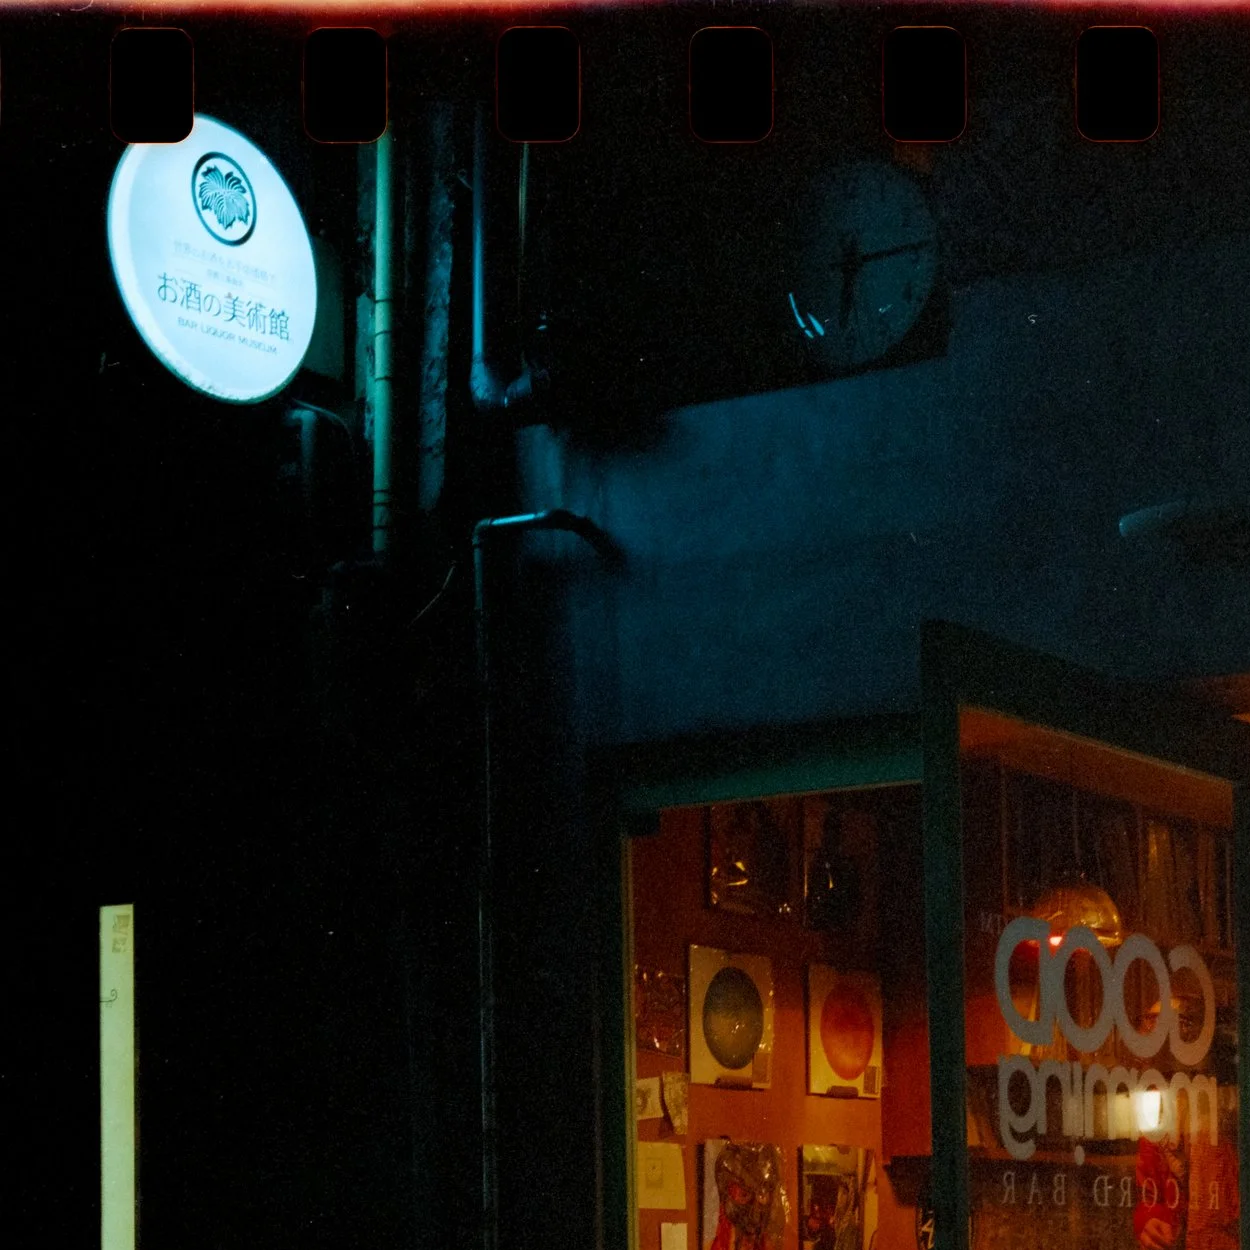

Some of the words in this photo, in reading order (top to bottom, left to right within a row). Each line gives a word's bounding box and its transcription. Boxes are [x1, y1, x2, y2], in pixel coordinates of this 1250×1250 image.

[158, 273, 290, 341] お酒の美術館
[178, 317, 198, 330] BAR
